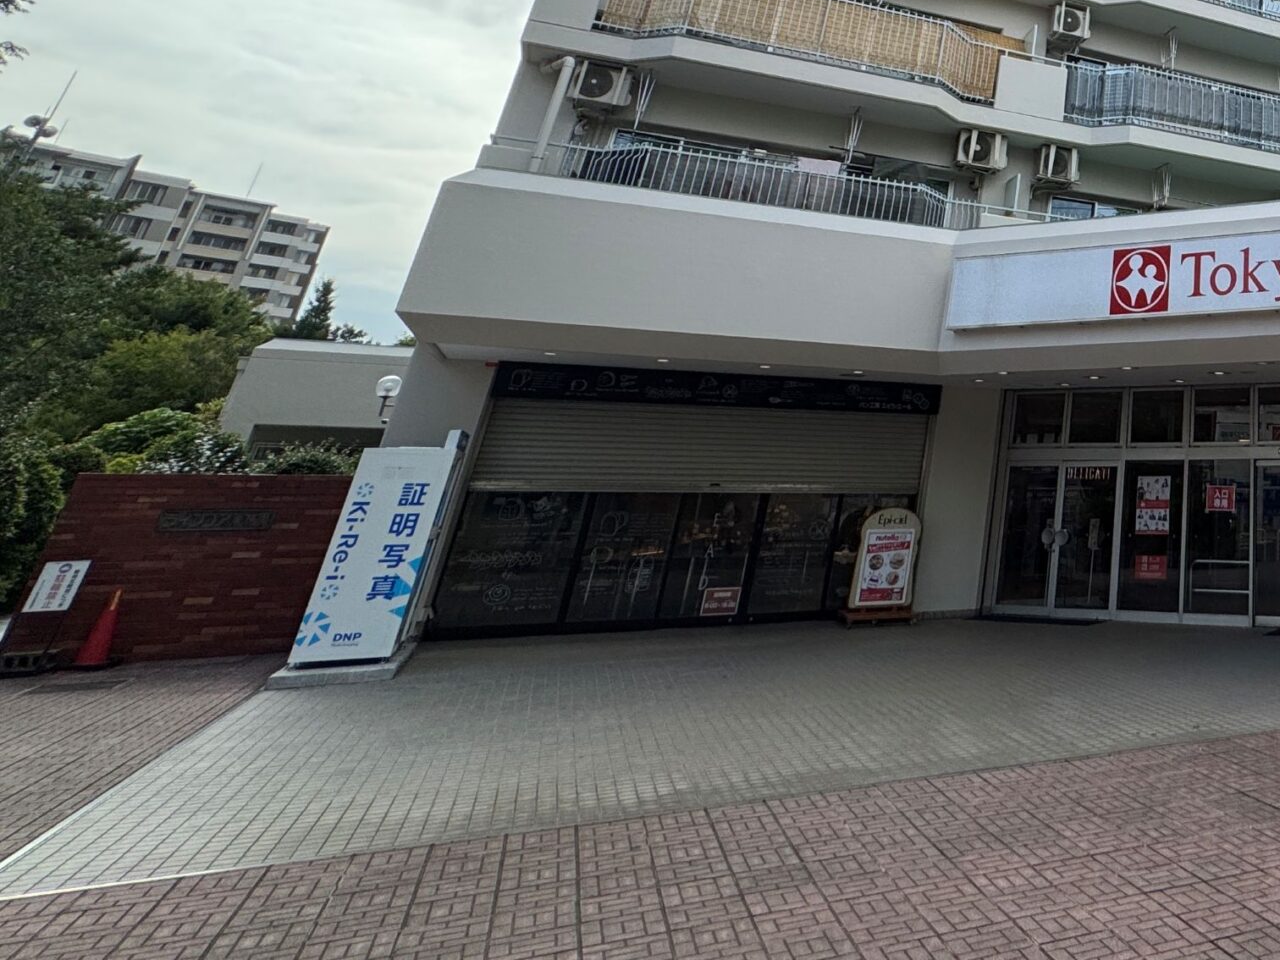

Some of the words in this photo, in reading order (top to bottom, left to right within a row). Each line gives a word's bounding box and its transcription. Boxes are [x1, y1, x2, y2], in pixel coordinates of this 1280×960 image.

[1213, 488, 1229, 498] 入口
[325, 501, 370, 581] Ki-Re-i
[365, 482, 431, 601] 証明写真
[332, 632, 362, 642] DNP
